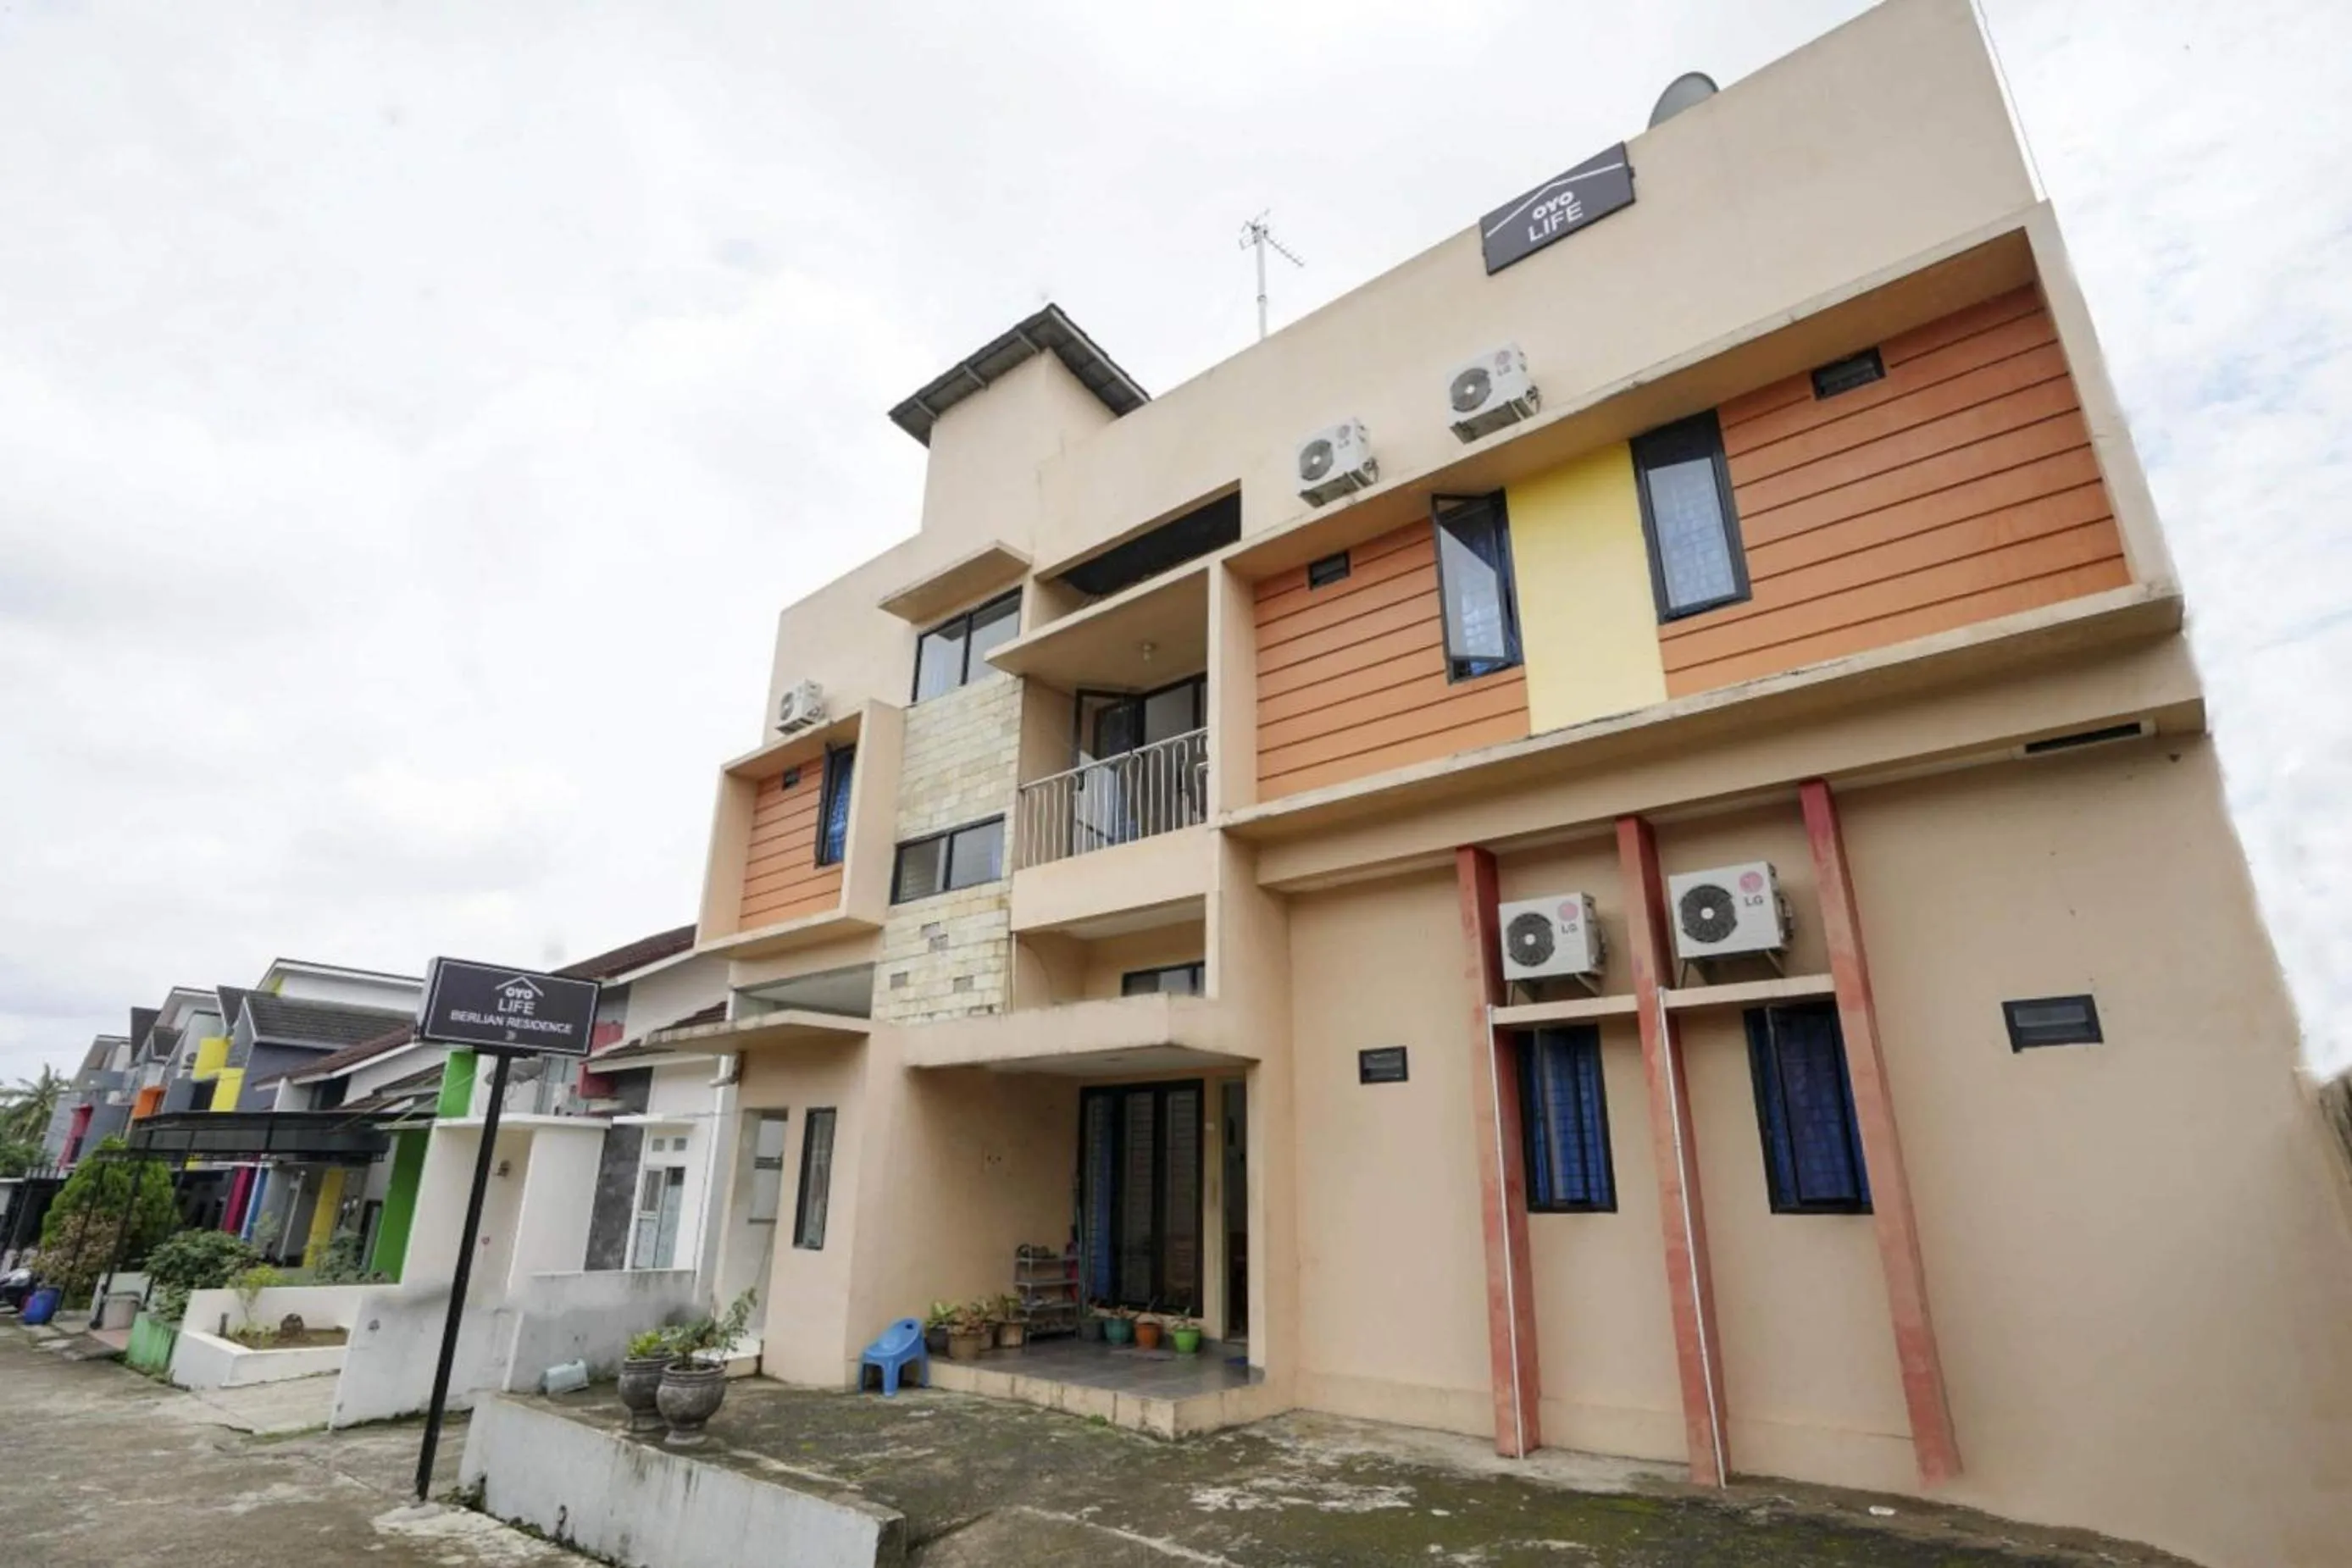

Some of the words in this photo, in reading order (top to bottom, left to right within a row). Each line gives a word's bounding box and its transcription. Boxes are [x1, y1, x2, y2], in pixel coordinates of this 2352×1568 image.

[1532, 191, 1574, 220] OYO
[1528, 201, 1583, 242] LIFE
[1745, 895, 1763, 906] LG
[1562, 923, 1578, 934] LG
[505, 987, 534, 1000] OYO
[497, 998, 535, 1016] LIFE
[450, 1010, 504, 1027] BERLIAN
[507, 1017, 573, 1034] RESIDENCE
